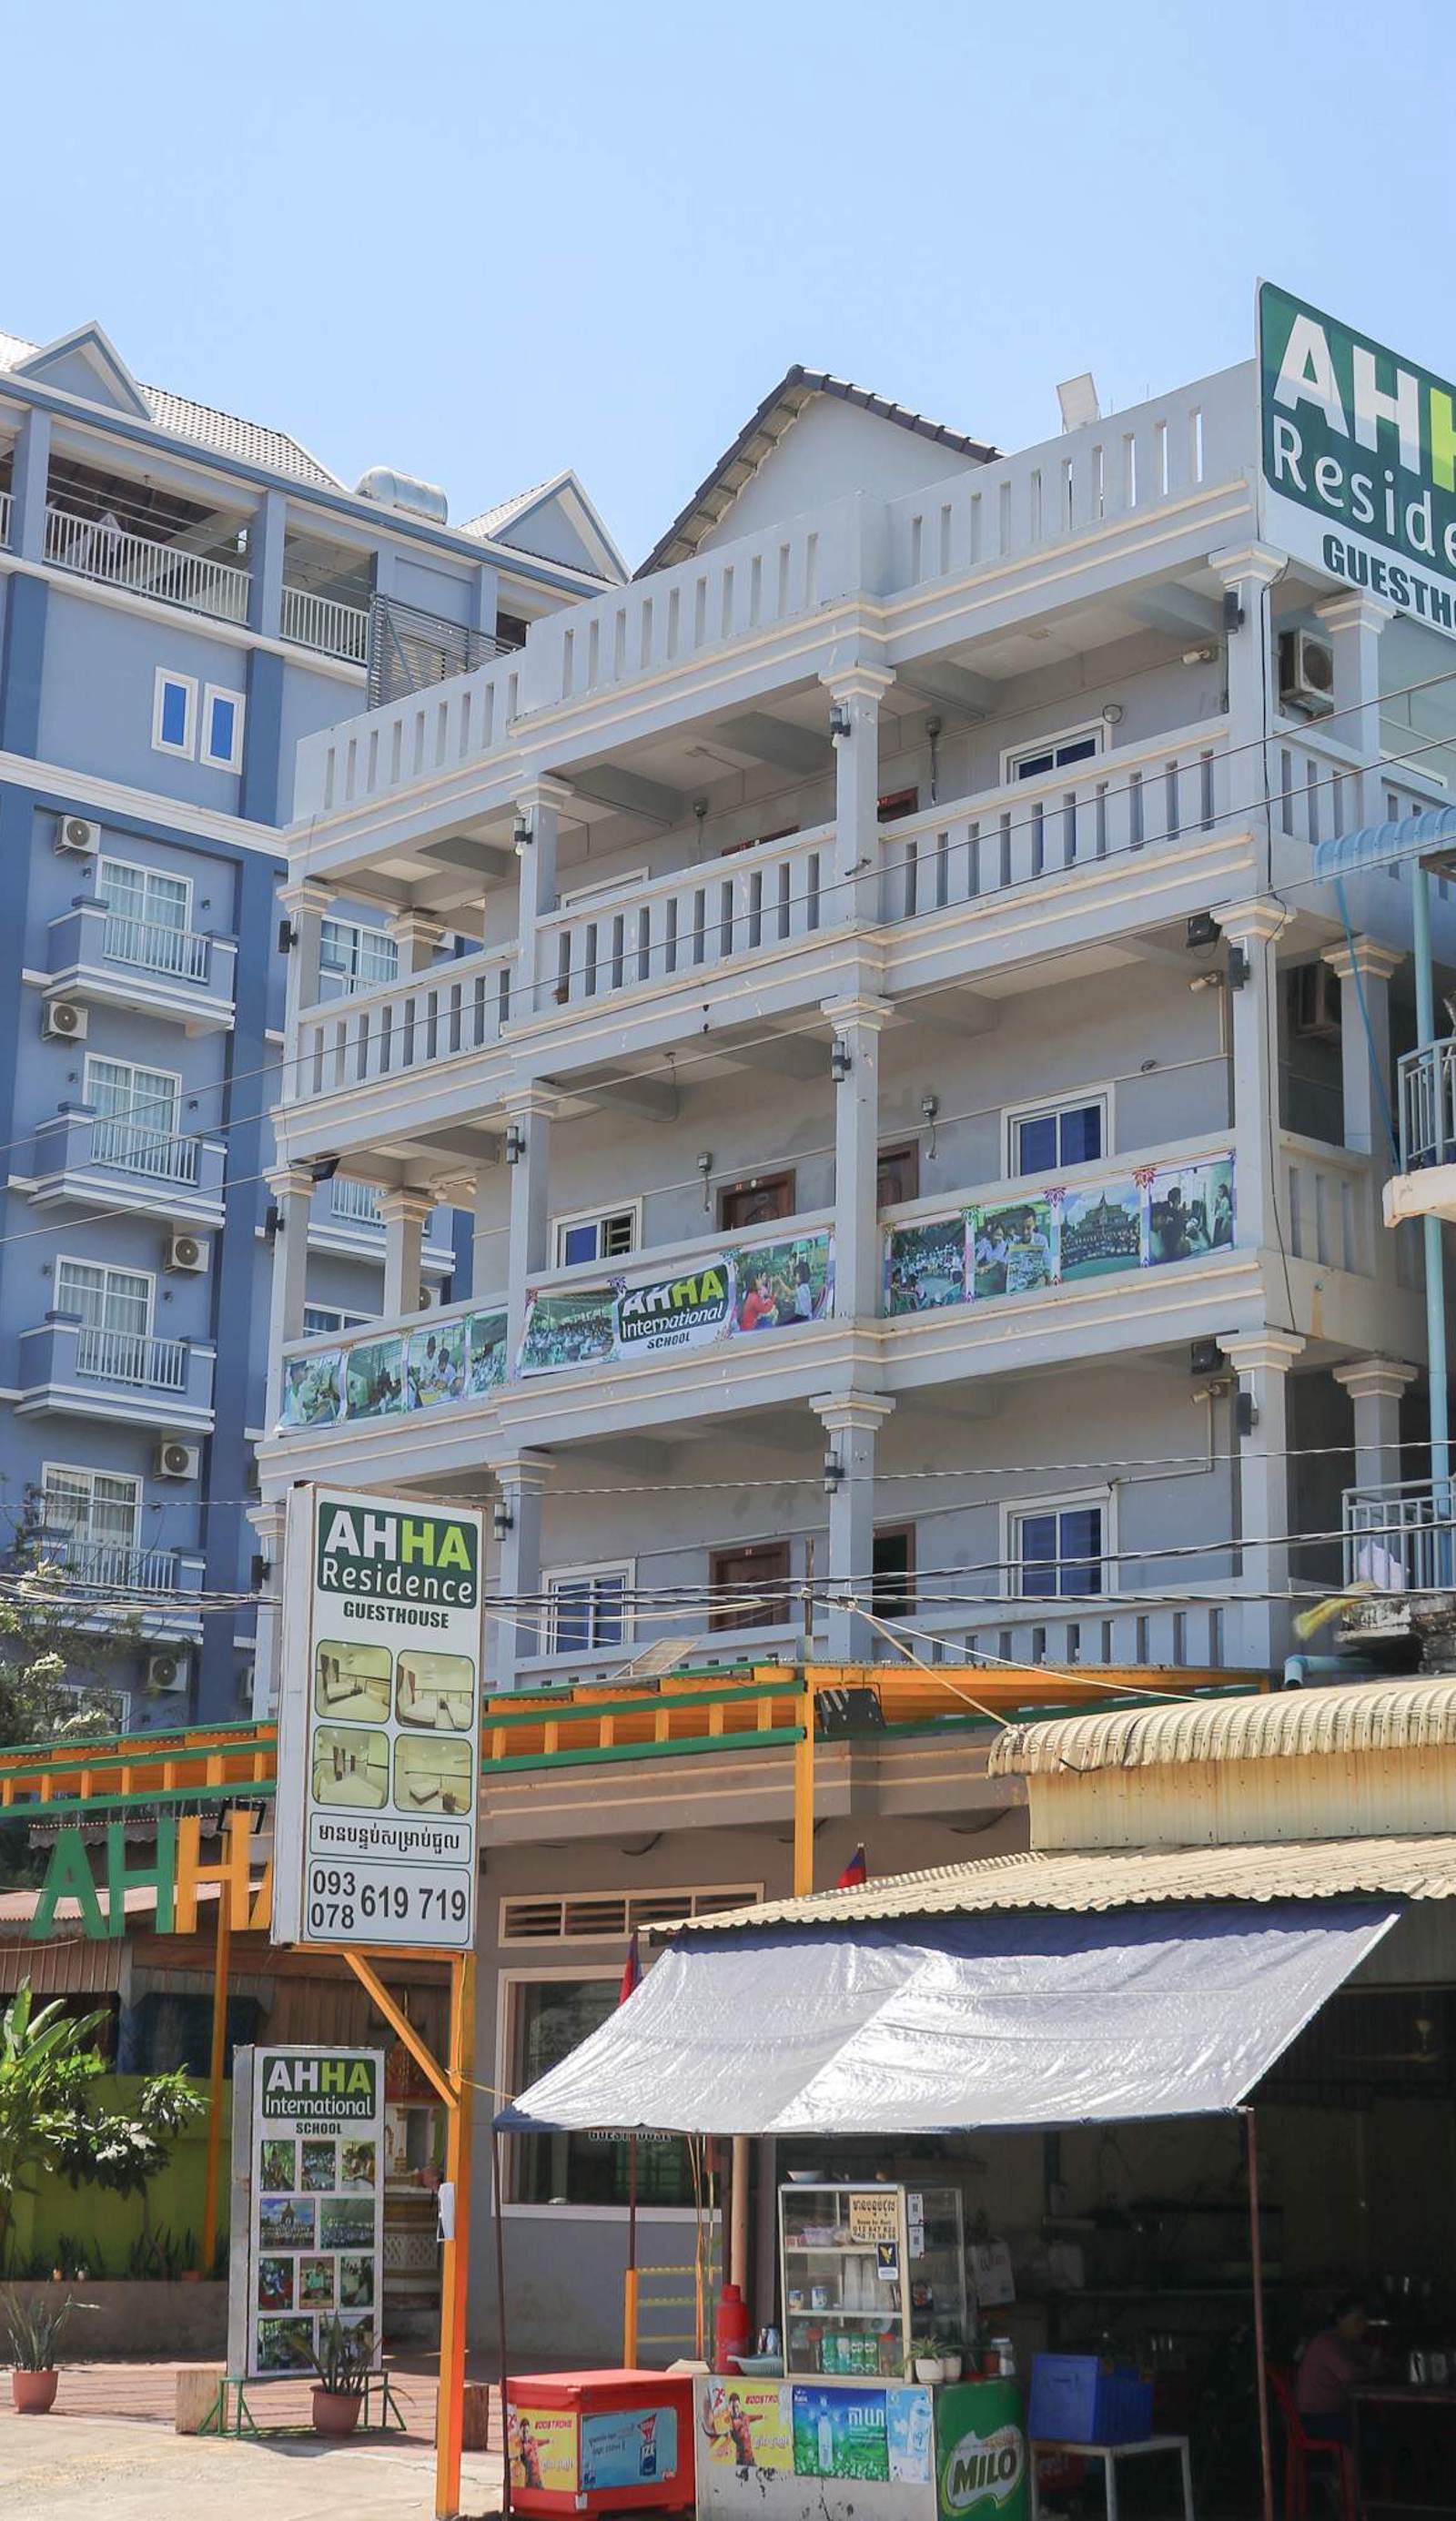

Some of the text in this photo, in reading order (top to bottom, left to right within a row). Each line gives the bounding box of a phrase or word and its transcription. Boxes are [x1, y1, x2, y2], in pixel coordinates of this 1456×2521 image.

[1322, 533, 1456, 630] GUESTH
[622, 1271, 724, 1317] AHHA
[622, 1301, 724, 1339] International
[647, 1331, 691, 1350] SCHOOL
[324, 1510, 472, 1571] AHHA
[322, 1557, 472, 1604] Residence
[343, 1601, 450, 1629] GUESTHOUSE
[313, 1869, 356, 1897] 093
[310, 1902, 354, 1929] 078
[360, 1884, 467, 1921] 619 719
[267, 2060, 371, 2093] AHHA
[266, 2094, 371, 2116] International
[296, 2121, 343, 2135] SCHOOL
[953, 2447, 1016, 2496] MILO
